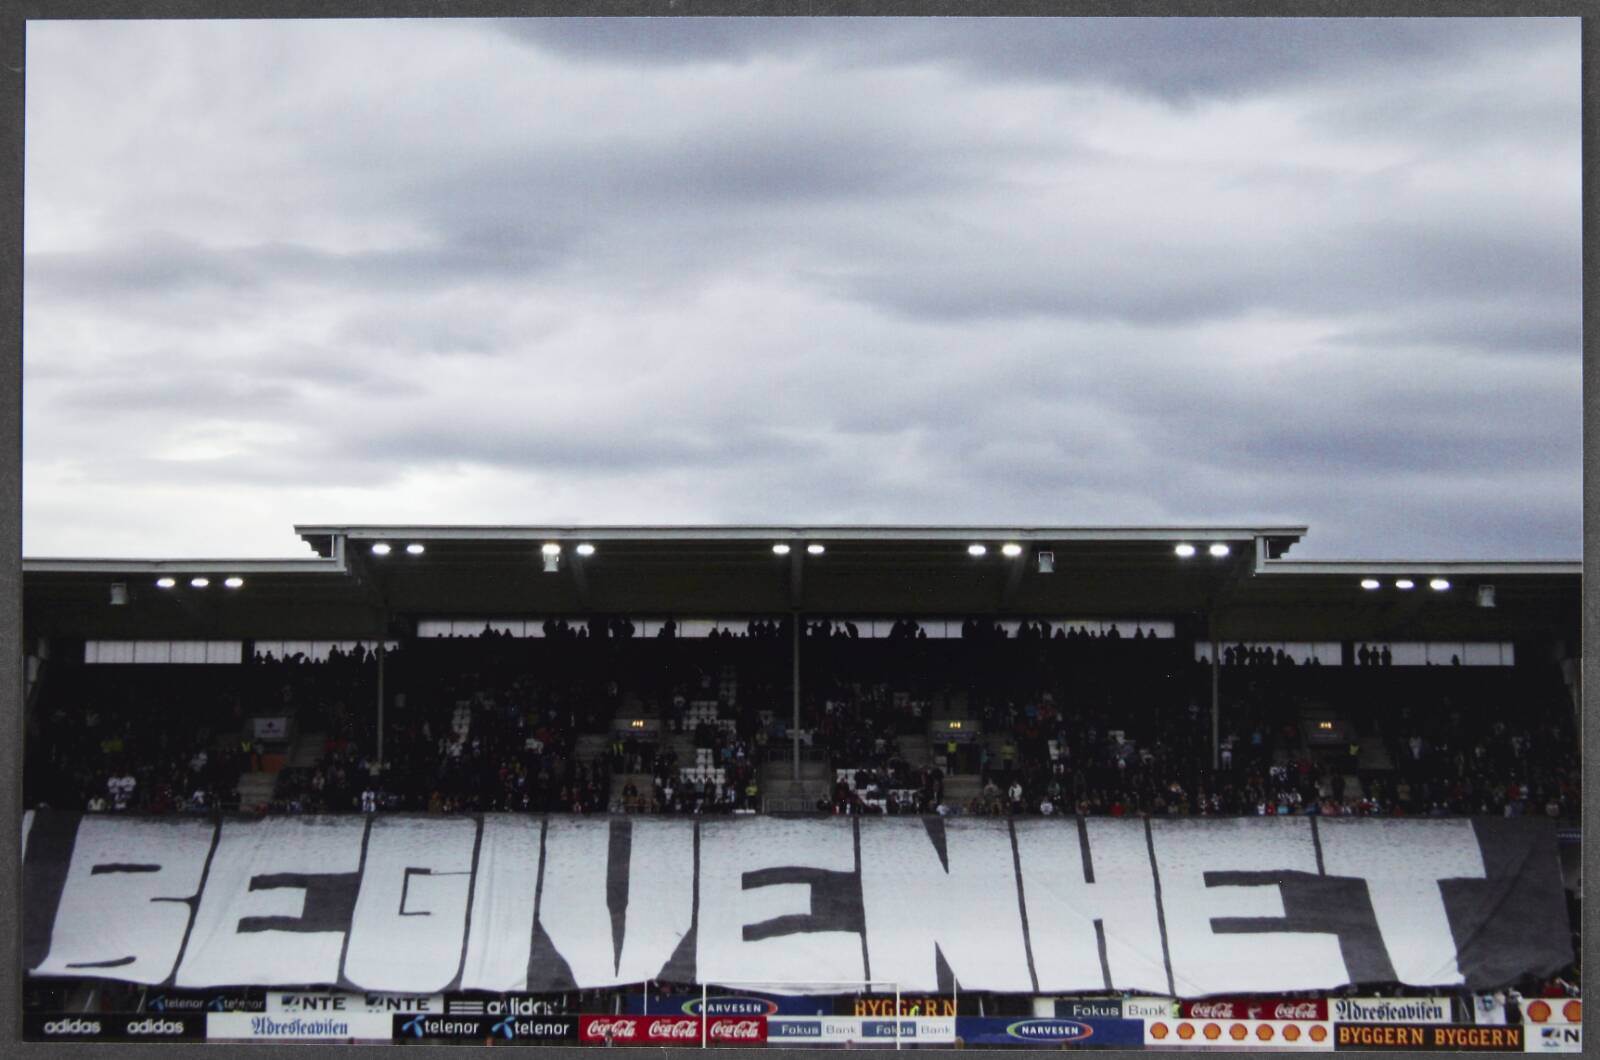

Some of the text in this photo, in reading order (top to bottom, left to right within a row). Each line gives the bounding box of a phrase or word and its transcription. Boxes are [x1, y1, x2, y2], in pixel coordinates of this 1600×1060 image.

[164, 1000, 204, 1008] telenor
[302, 997, 347, 1011] NTE
[386, 998, 432, 1011] NTE
[1073, 1005, 1167, 1016] Fokus Bank
[44, 1019, 101, 1034] adidas
[127, 1019, 184, 1034] adidas
[424, 1020, 480, 1035] telenor
[514, 1020, 570, 1036] telenor
[781, 1024, 856, 1035] Fokus Bank
[921, 1025, 951, 1034] Bank
[1021, 1025, 1079, 1036] NARVESEN
